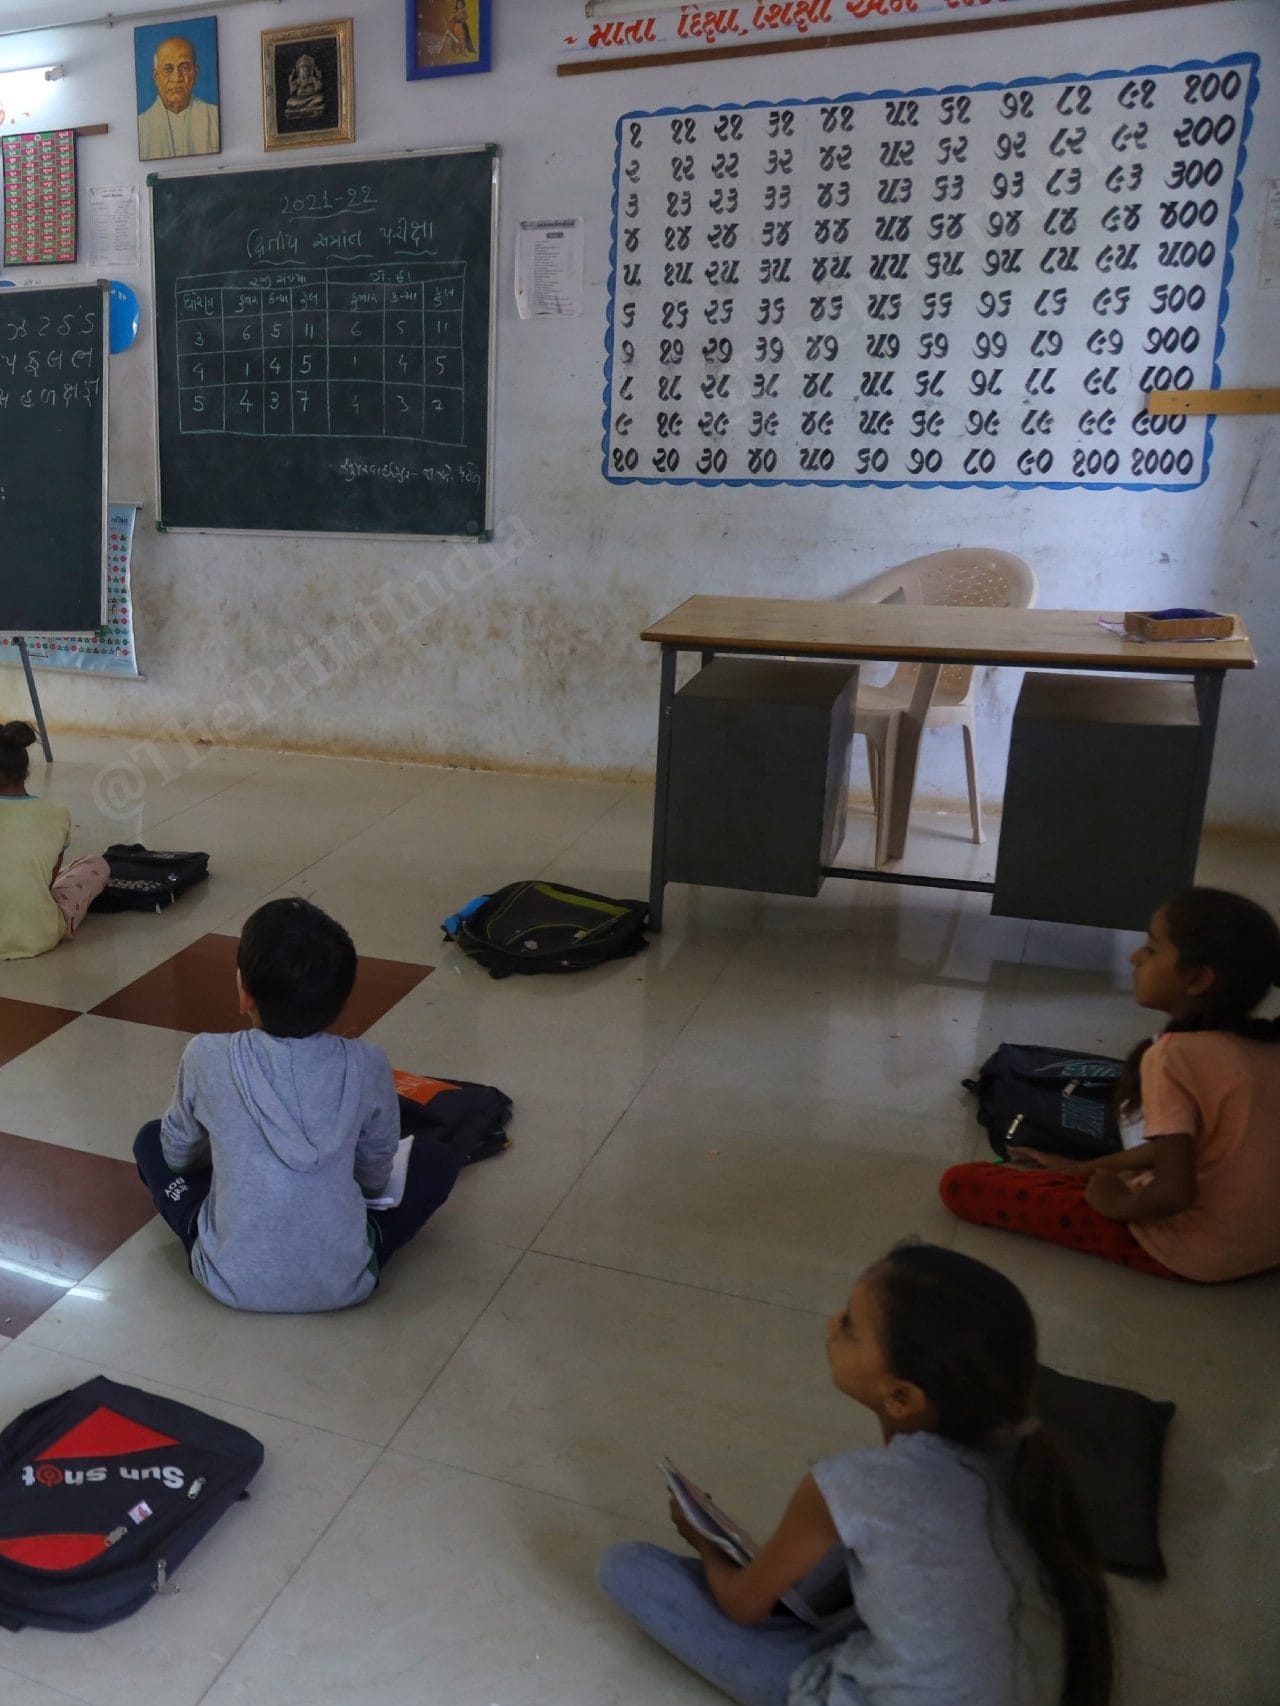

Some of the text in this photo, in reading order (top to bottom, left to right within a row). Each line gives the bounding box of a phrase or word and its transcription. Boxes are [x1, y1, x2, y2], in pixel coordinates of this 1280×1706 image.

[588, 17, 657, 48] માતા
[629, 69, 1242, 150] ૧ ૧૧ ૨૧ ૩૧ ૪૧ ૫૧ ૬૧ ૭૧ ૮૧ ૯૧ ૧૦૦
[624, 114, 1237, 184] ૨ ૧૨ ૨૨ ૩૨ ૪૨ ૫૨ ૬૨ ૭૨ ૮૨ ૯૨ ૨૦૦
[280, 185, 378, 214] 2021-22
[624, 157, 1224, 219] ૩ ૧૩ ૨૩ ૩૩ ૪૩ ૫૩ ૬૩ ૭૩ ૮૩ ૯૩ ૩૦૦
[379, 217, 433, 248] પરીક્ષા
[623, 198, 1219, 254] ૪ ૧૪ ૨૪ ૩૪ ૪૪ ૫૪ ૬૪ ૭૪ ૮૪ ૯૪ ૪૦૦
[623, 239, 1216, 288] ૫ ૧૫ ૨૫ ૩૫ ૪૫ ૫૫ ૬૫ ૭૫ ૮૫ ૯૫ ૫૦૦
[621, 283, 1207, 330] ૬ ૧૬ ૨૬ ૩૬ ૪૬ ૫૬ ૬૬ ૭૬ ૮૬ ૯૬ ૬૦૦
[242, 325, 251, 340] 6
[270, 323, 282, 338] 5
[350, 320, 362, 337] 6
[192, 362, 205, 382] 4
[269, 354, 281, 376] 4
[301, 354, 313, 374] 5
[435, 355, 448, 376] 5
[192, 396, 205, 412] 5
[239, 393, 254, 414] 4
[270, 392, 279, 410] 3
[296, 390, 310, 412] 7
[611, 447, 1195, 478] ૧૦ ૨૦ ૩૦ ૪૦ ૫૦ ૬૦ ૭૦ ૮૦ ૯૦ ૧૦૦ ૧૦૦૦
[120, 1465, 185, 1489] Sun
